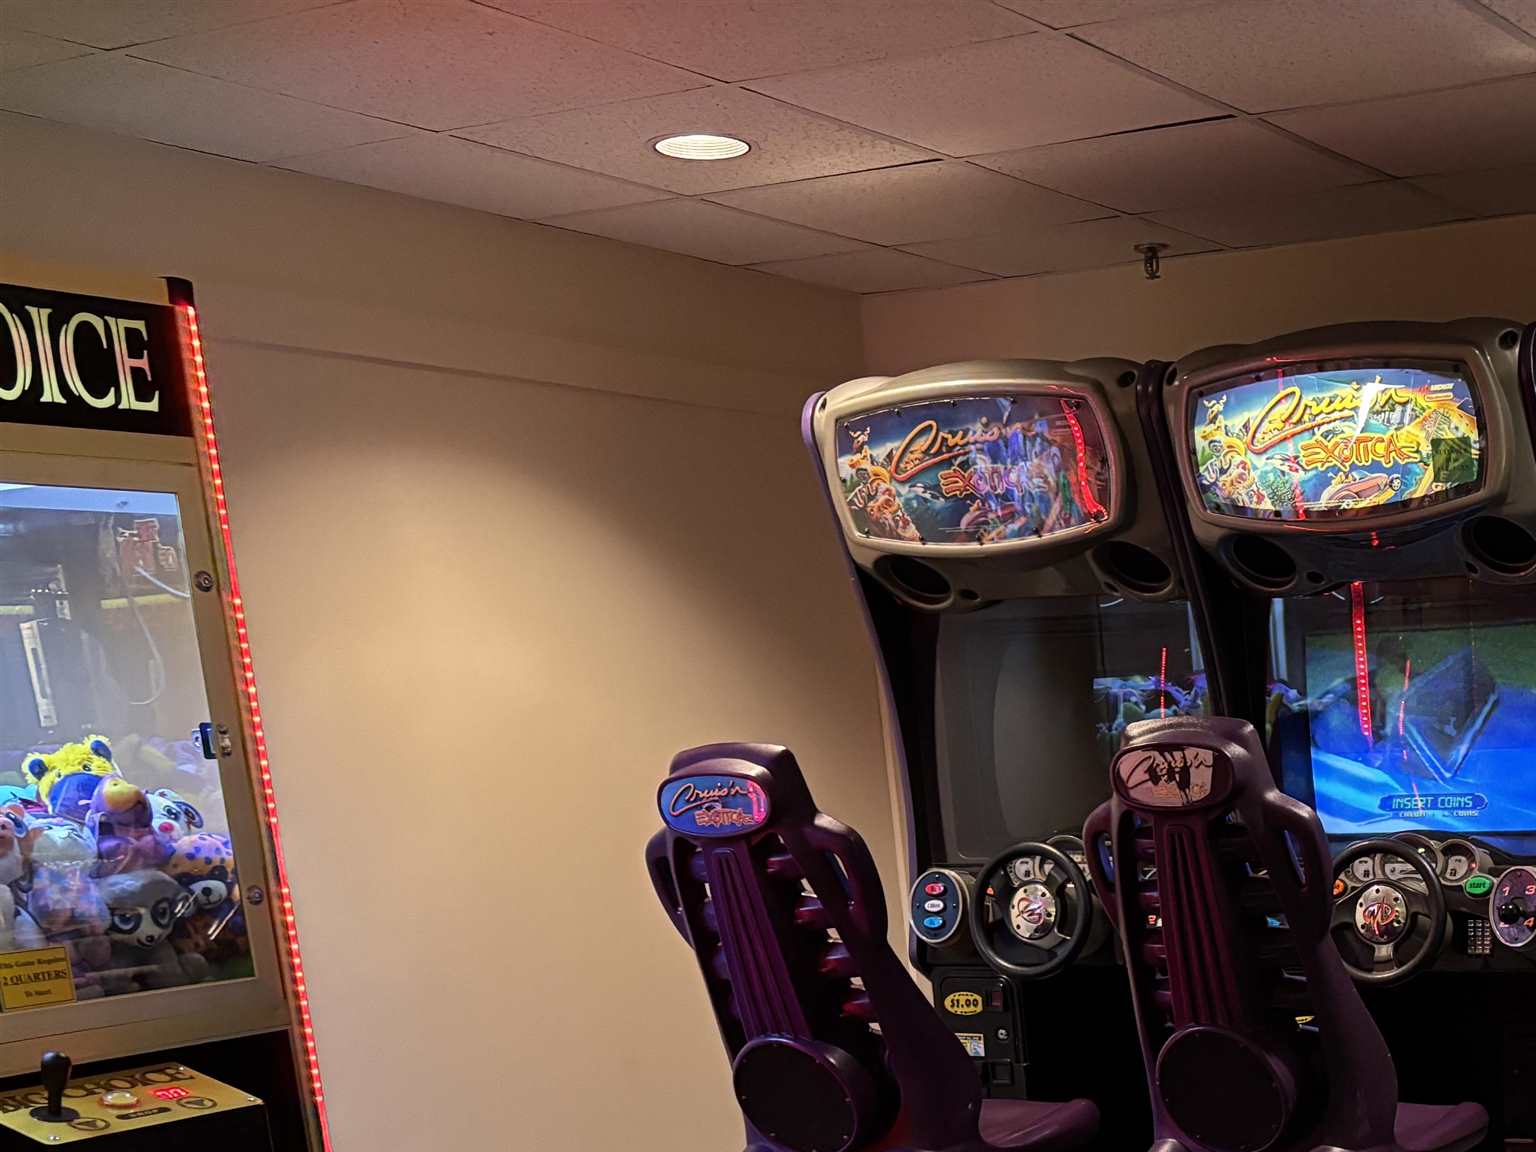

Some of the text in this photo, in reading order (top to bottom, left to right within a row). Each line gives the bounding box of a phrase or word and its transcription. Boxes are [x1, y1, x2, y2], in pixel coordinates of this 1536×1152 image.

[1301, 432, 1421, 471] EXOTICA
[670, 780, 748, 816] Cruis'n
[1392, 796, 1473, 809] INSERT COINS
[1502, 884, 1536, 896] 1 3
[1523, 917, 1535, 927] 4
[10, 970, 67, 985] QUARTERS
